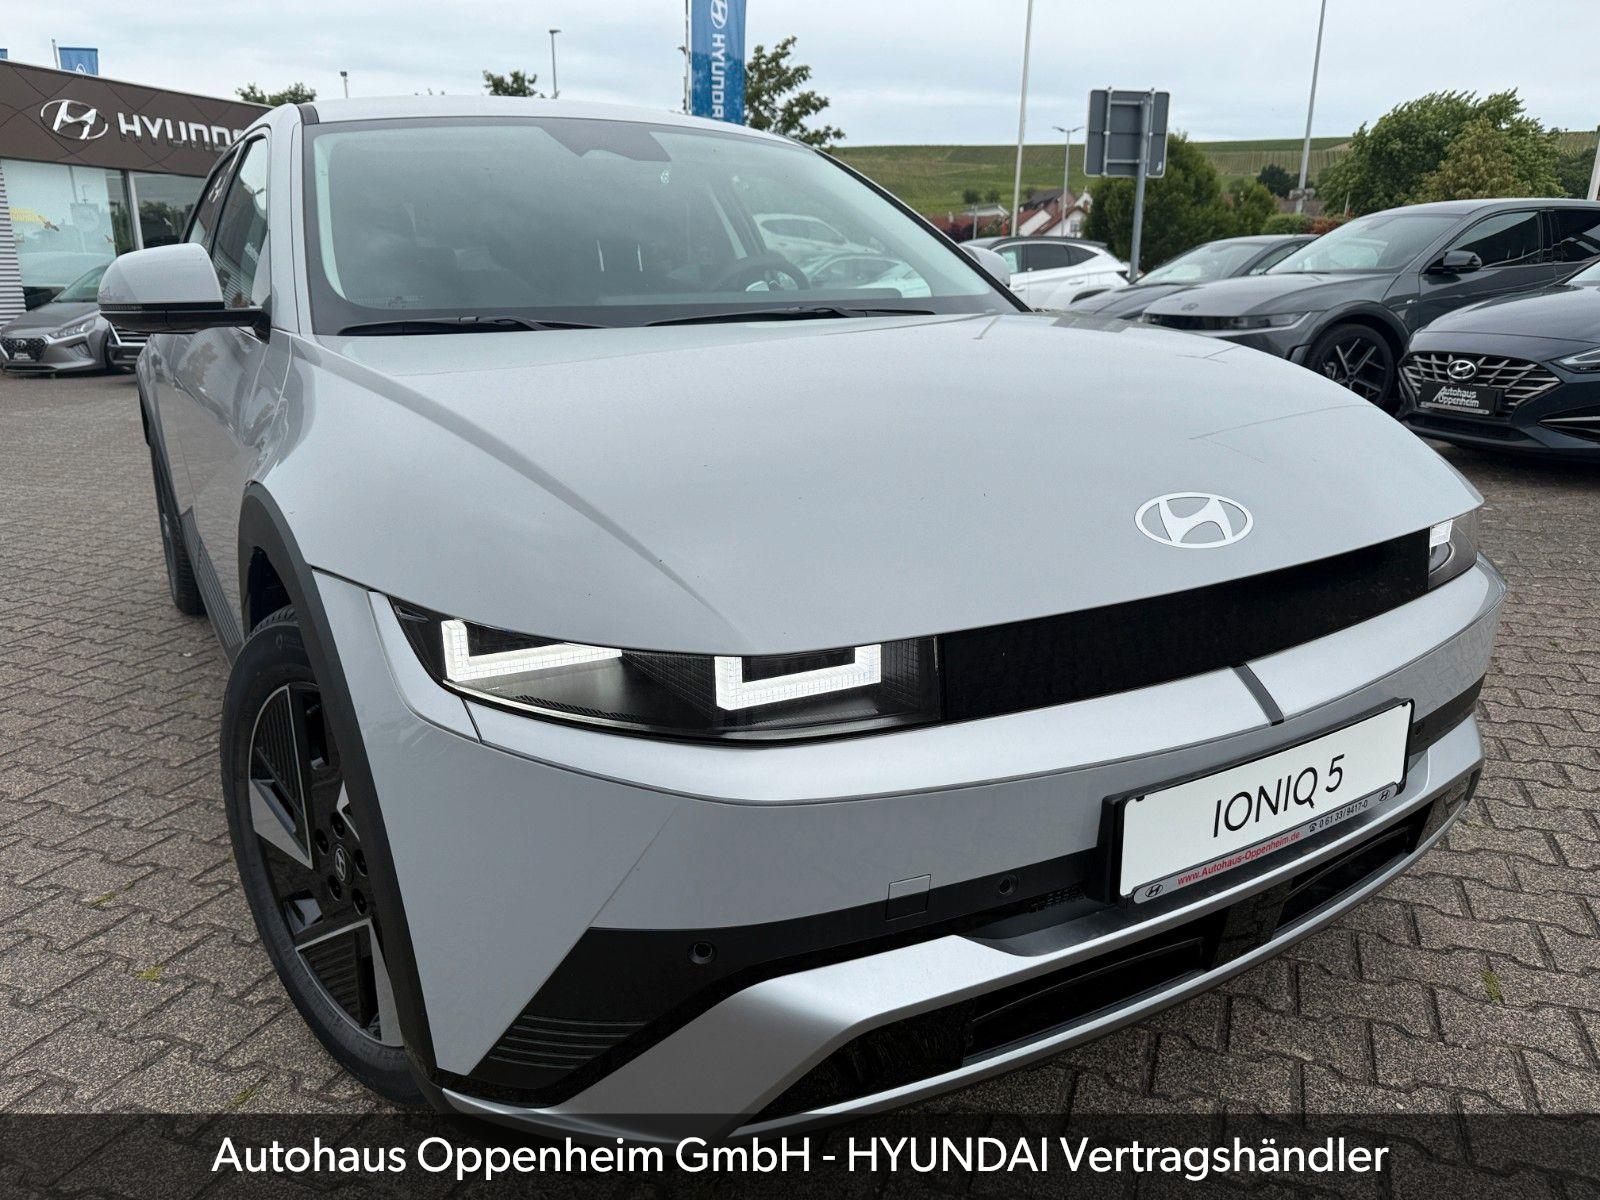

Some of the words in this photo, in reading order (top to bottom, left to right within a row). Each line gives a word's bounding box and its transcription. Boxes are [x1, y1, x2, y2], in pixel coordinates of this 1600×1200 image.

[1432, 386, 1477, 401] Autohaus
[1437, 394, 1480, 408] Oppenheim
[1213, 766, 1318, 838] IONIQ
[1325, 753, 1345, 793] 5
[1176, 830, 1301, 886] www.Autohaus-Oppenheim.de
